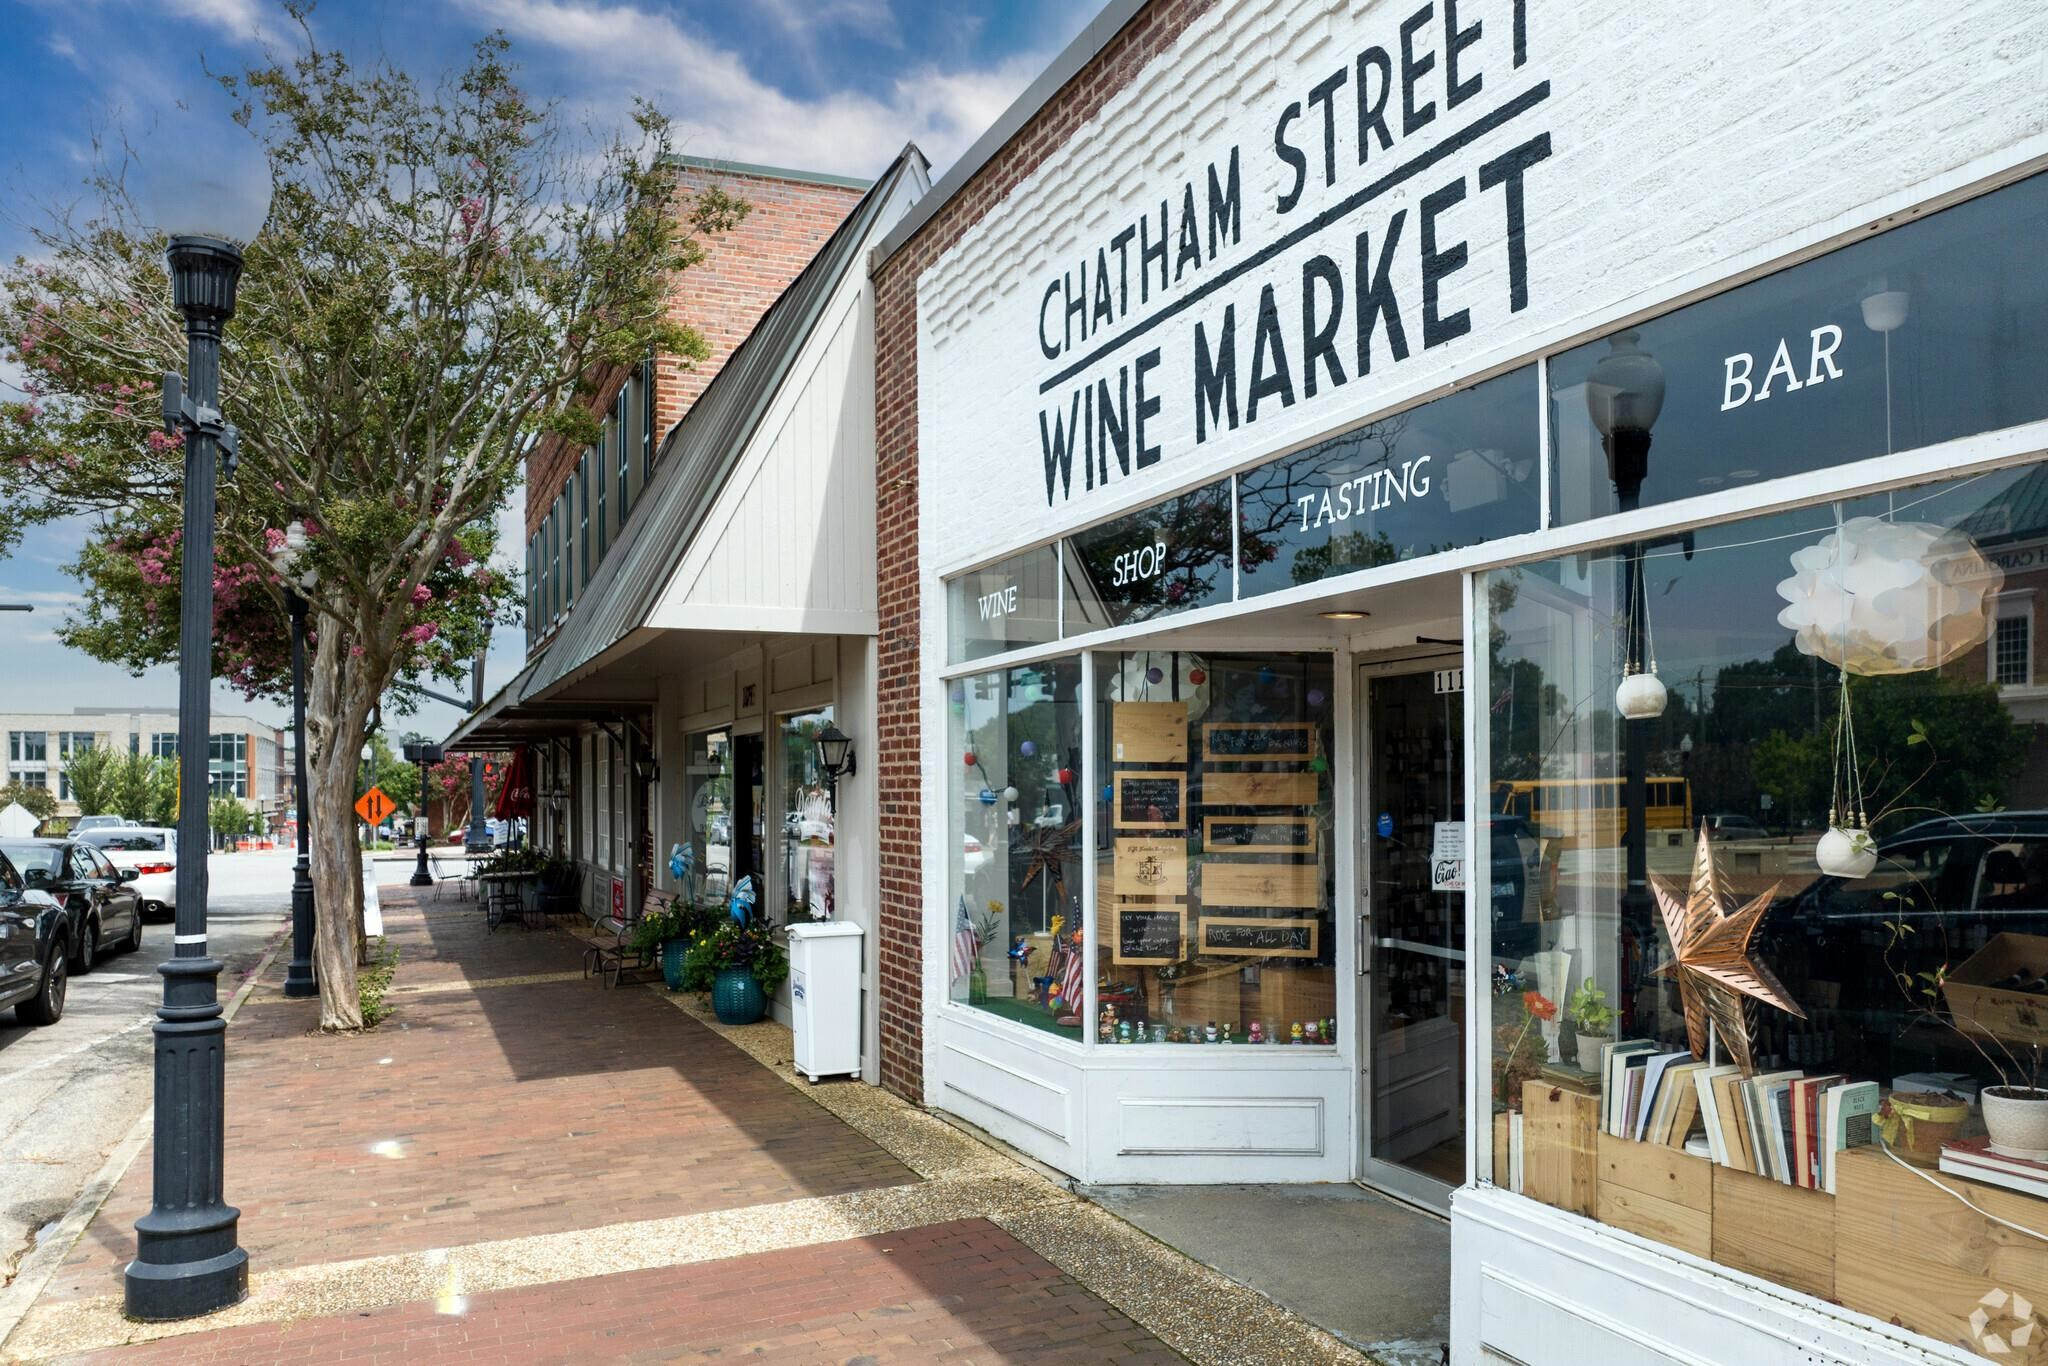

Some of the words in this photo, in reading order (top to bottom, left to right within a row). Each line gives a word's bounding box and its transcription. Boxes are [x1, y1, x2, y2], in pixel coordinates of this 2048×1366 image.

[1039, 145, 1241, 360] CHATHAM
[1039, 346, 1161, 508] WINE
[1195, 131, 1552, 444] MARKET
[978, 586, 1017, 623] WINE
[1113, 542, 1166, 587] SHOP
[1298, 456, 1432, 532] TASTING
[1721, 324, 1844, 411] BAR
[1236, 927, 1253, 937] FOR
[1256, 931, 1277, 943] ALL
[1281, 930, 1306, 945] DAY
